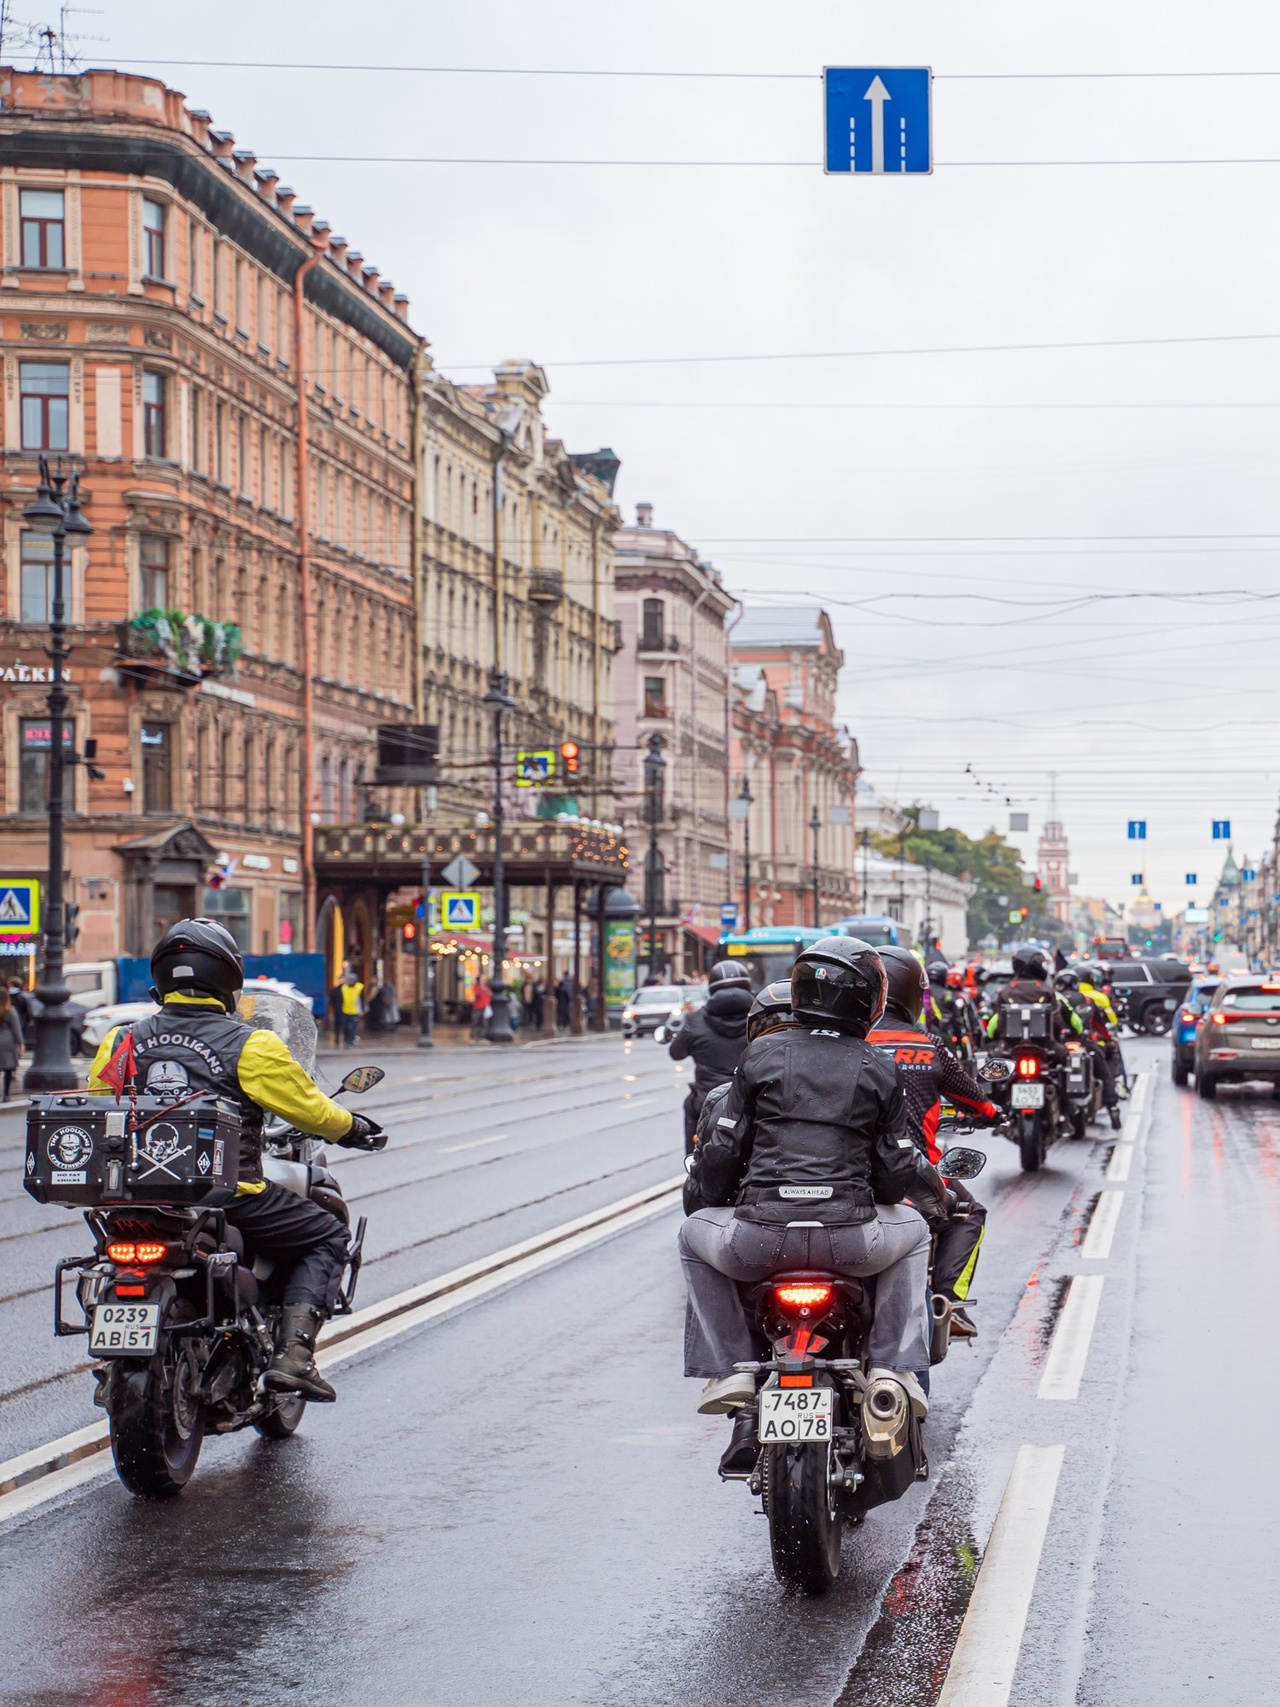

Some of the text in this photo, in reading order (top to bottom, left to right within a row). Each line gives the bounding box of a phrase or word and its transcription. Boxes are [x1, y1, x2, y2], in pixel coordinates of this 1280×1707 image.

[810, 1029, 840, 1038] LS2
[147, 1034, 225, 1075] HOOLIGANS
[103, 1308, 149, 1323] 0239
[128, 1331, 150, 1347] 51
[771, 1392, 822, 1411] 7487
[802, 1419, 828, 1437] 78
